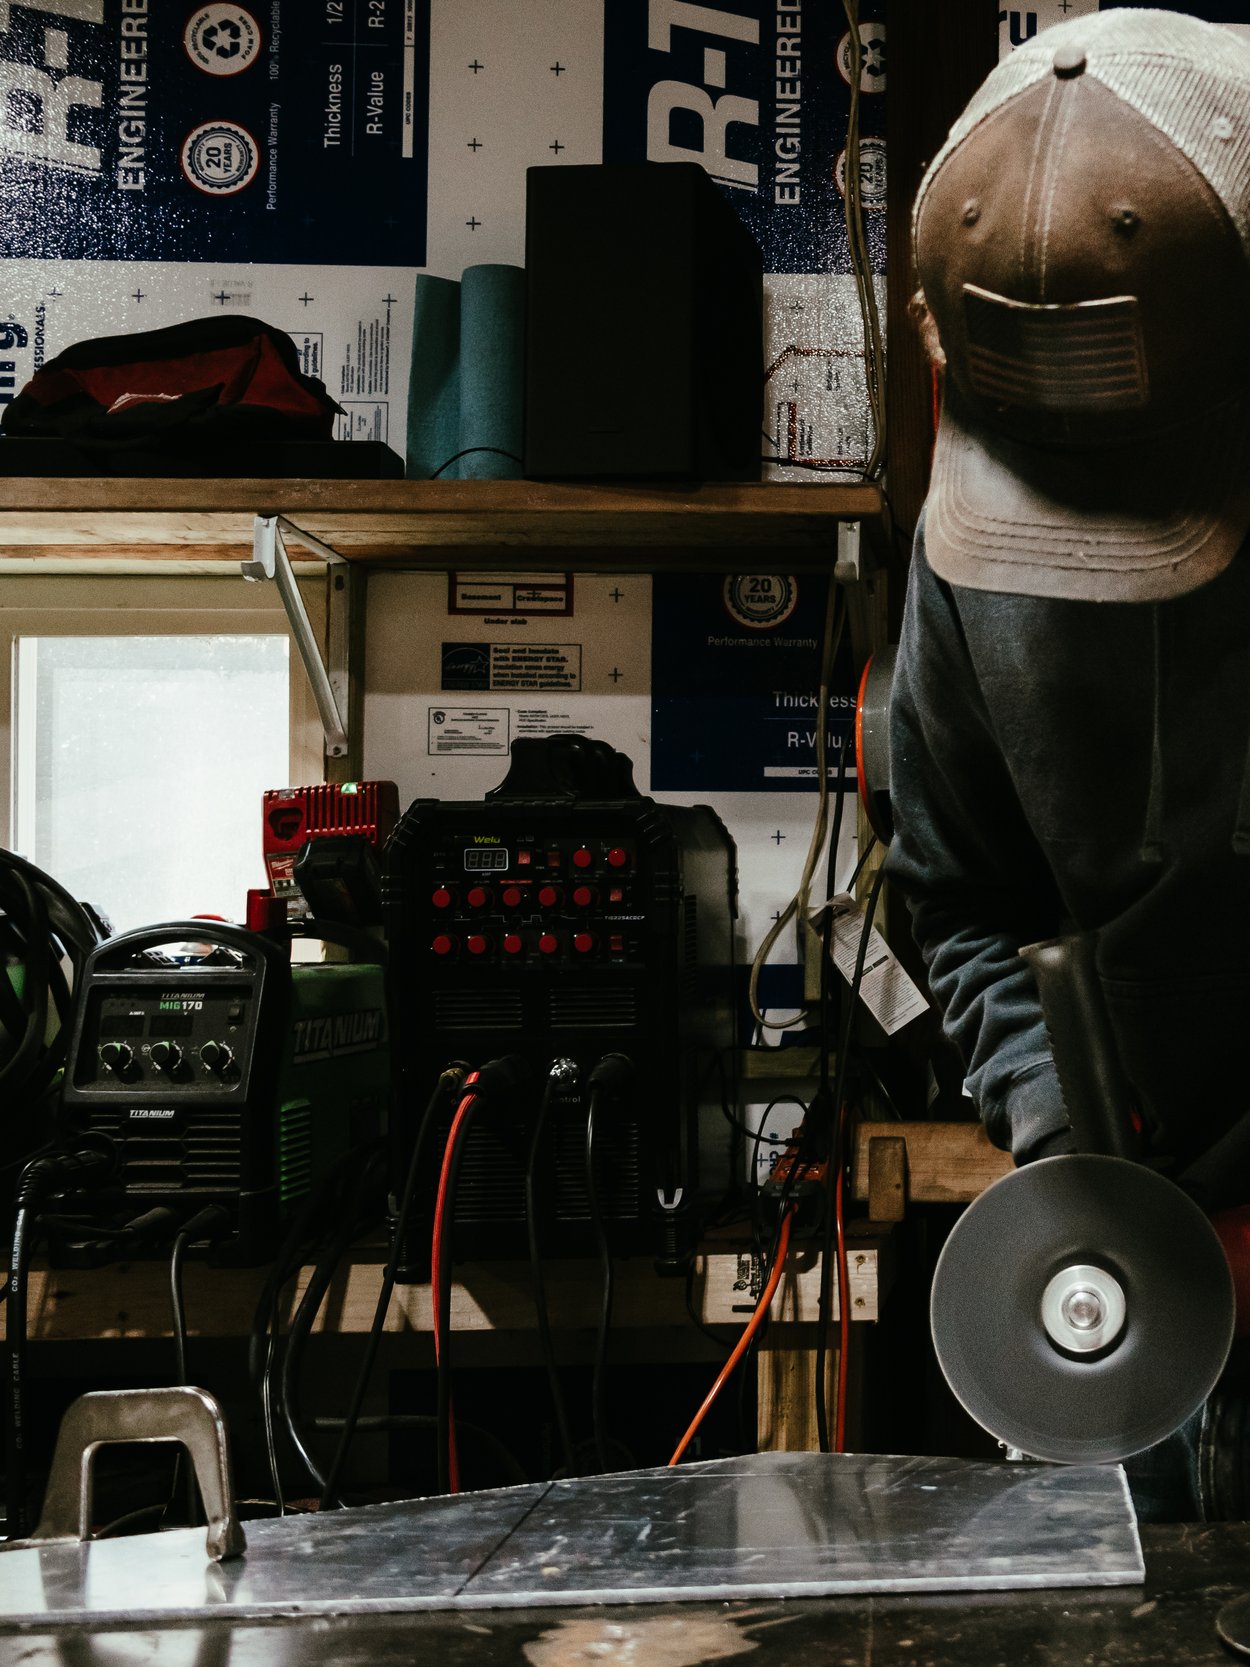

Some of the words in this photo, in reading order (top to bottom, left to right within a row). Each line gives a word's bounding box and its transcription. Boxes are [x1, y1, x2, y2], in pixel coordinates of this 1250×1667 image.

[269, 0, 283, 53] Recyclable
[241, 38, 254, 60] FOAM
[323, 64, 343, 148] Thickness
[366, 71, 385, 135] R-Value
[267, 102, 282, 146] Warranty
[206, 147, 221, 168] 20
[224, 143, 232, 173] YEARS
[266, 149, 277, 210] Performance
[744, 594, 776, 604] YEARS
[750, 578, 771, 593] 20
[707, 636, 770, 647] Performance
[774, 637, 818, 649] Warranty
[772, 691, 857, 709] Thickess
[161, 992, 205, 1000] TITANIUM
[294, 1012, 380, 1053] TITANIUM
[129, 1109, 175, 1118] TITANIUM
[12, 1231, 21, 1270] WELDING
[14, 1388, 22, 1427] WELDING
